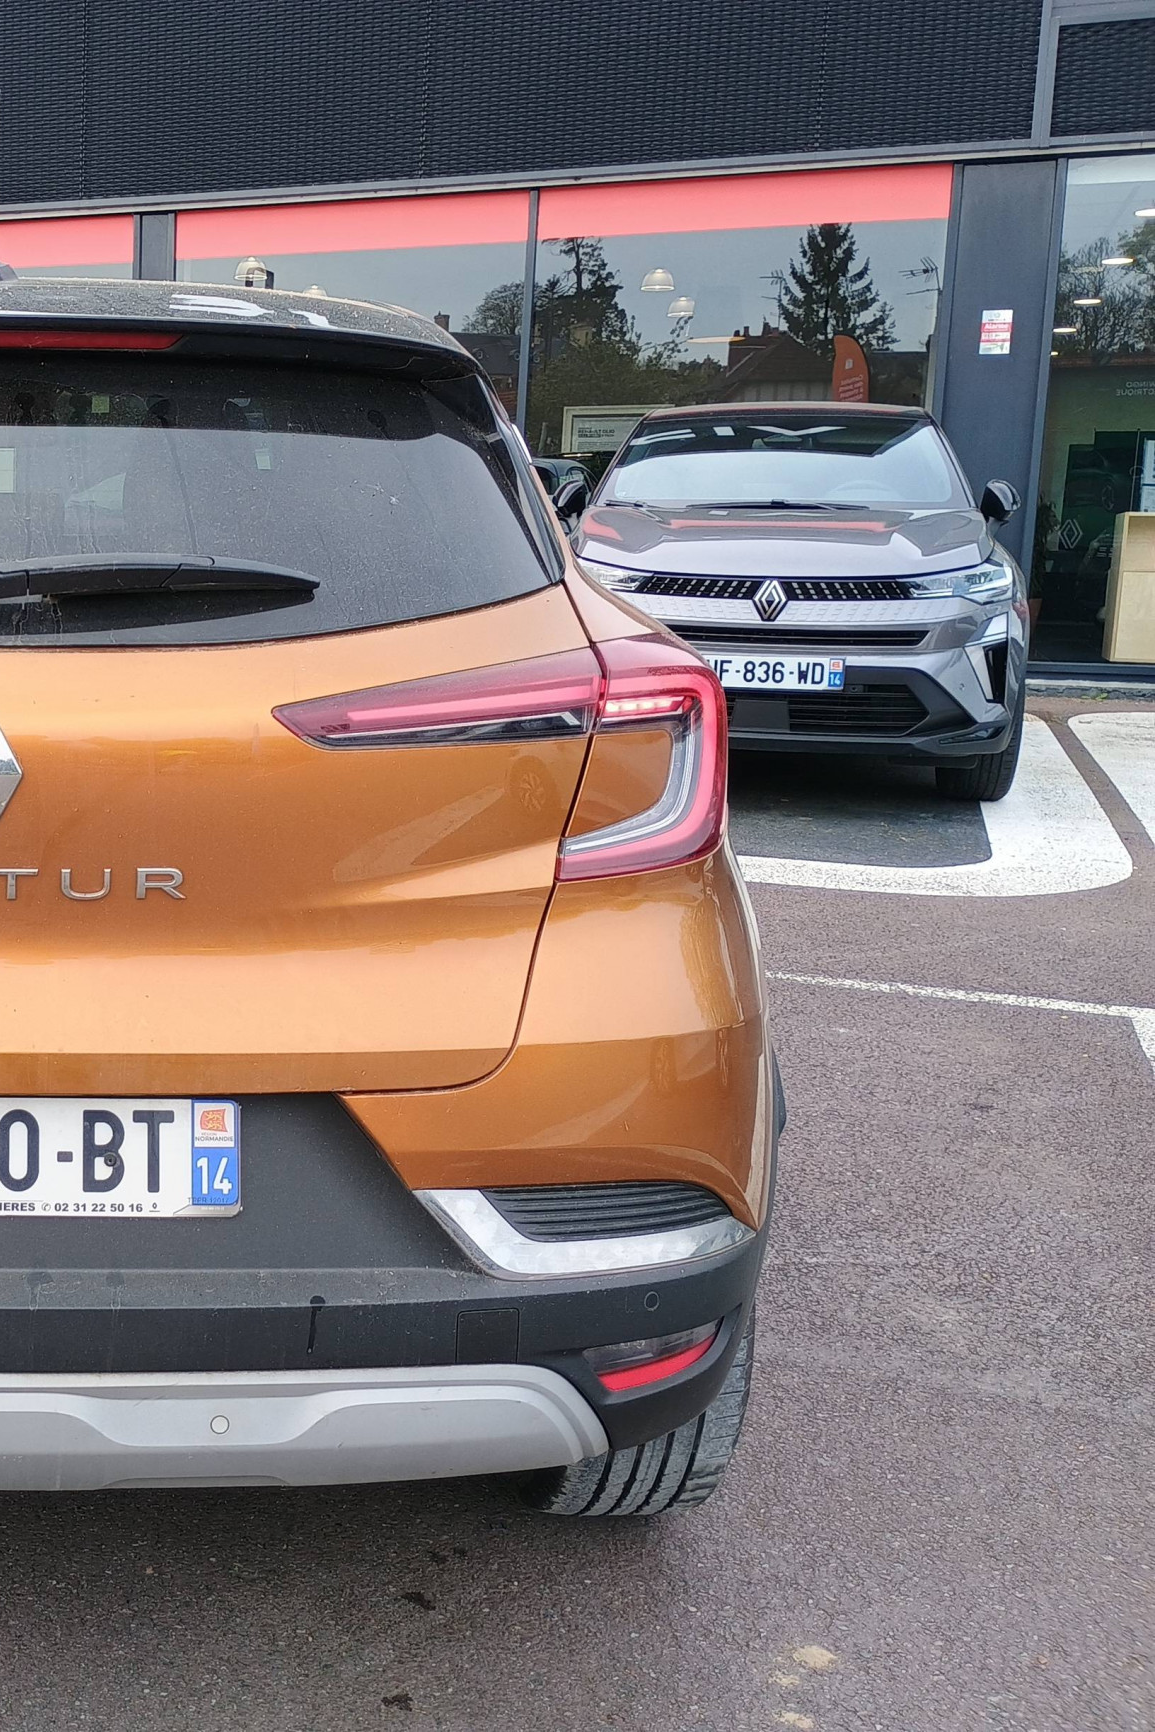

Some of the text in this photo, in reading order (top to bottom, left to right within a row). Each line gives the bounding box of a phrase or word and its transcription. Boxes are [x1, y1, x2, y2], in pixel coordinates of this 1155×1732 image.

[829, 674, 841, 686] 14
[196, 1156, 233, 1195] 14
[54, 1203, 69, 1212] 02
[73, 1203, 87, 1212] 31
[91, 1203, 105, 1212] 22
[109, 1203, 125, 1212] 50
[129, 1203, 143, 1212] 16
